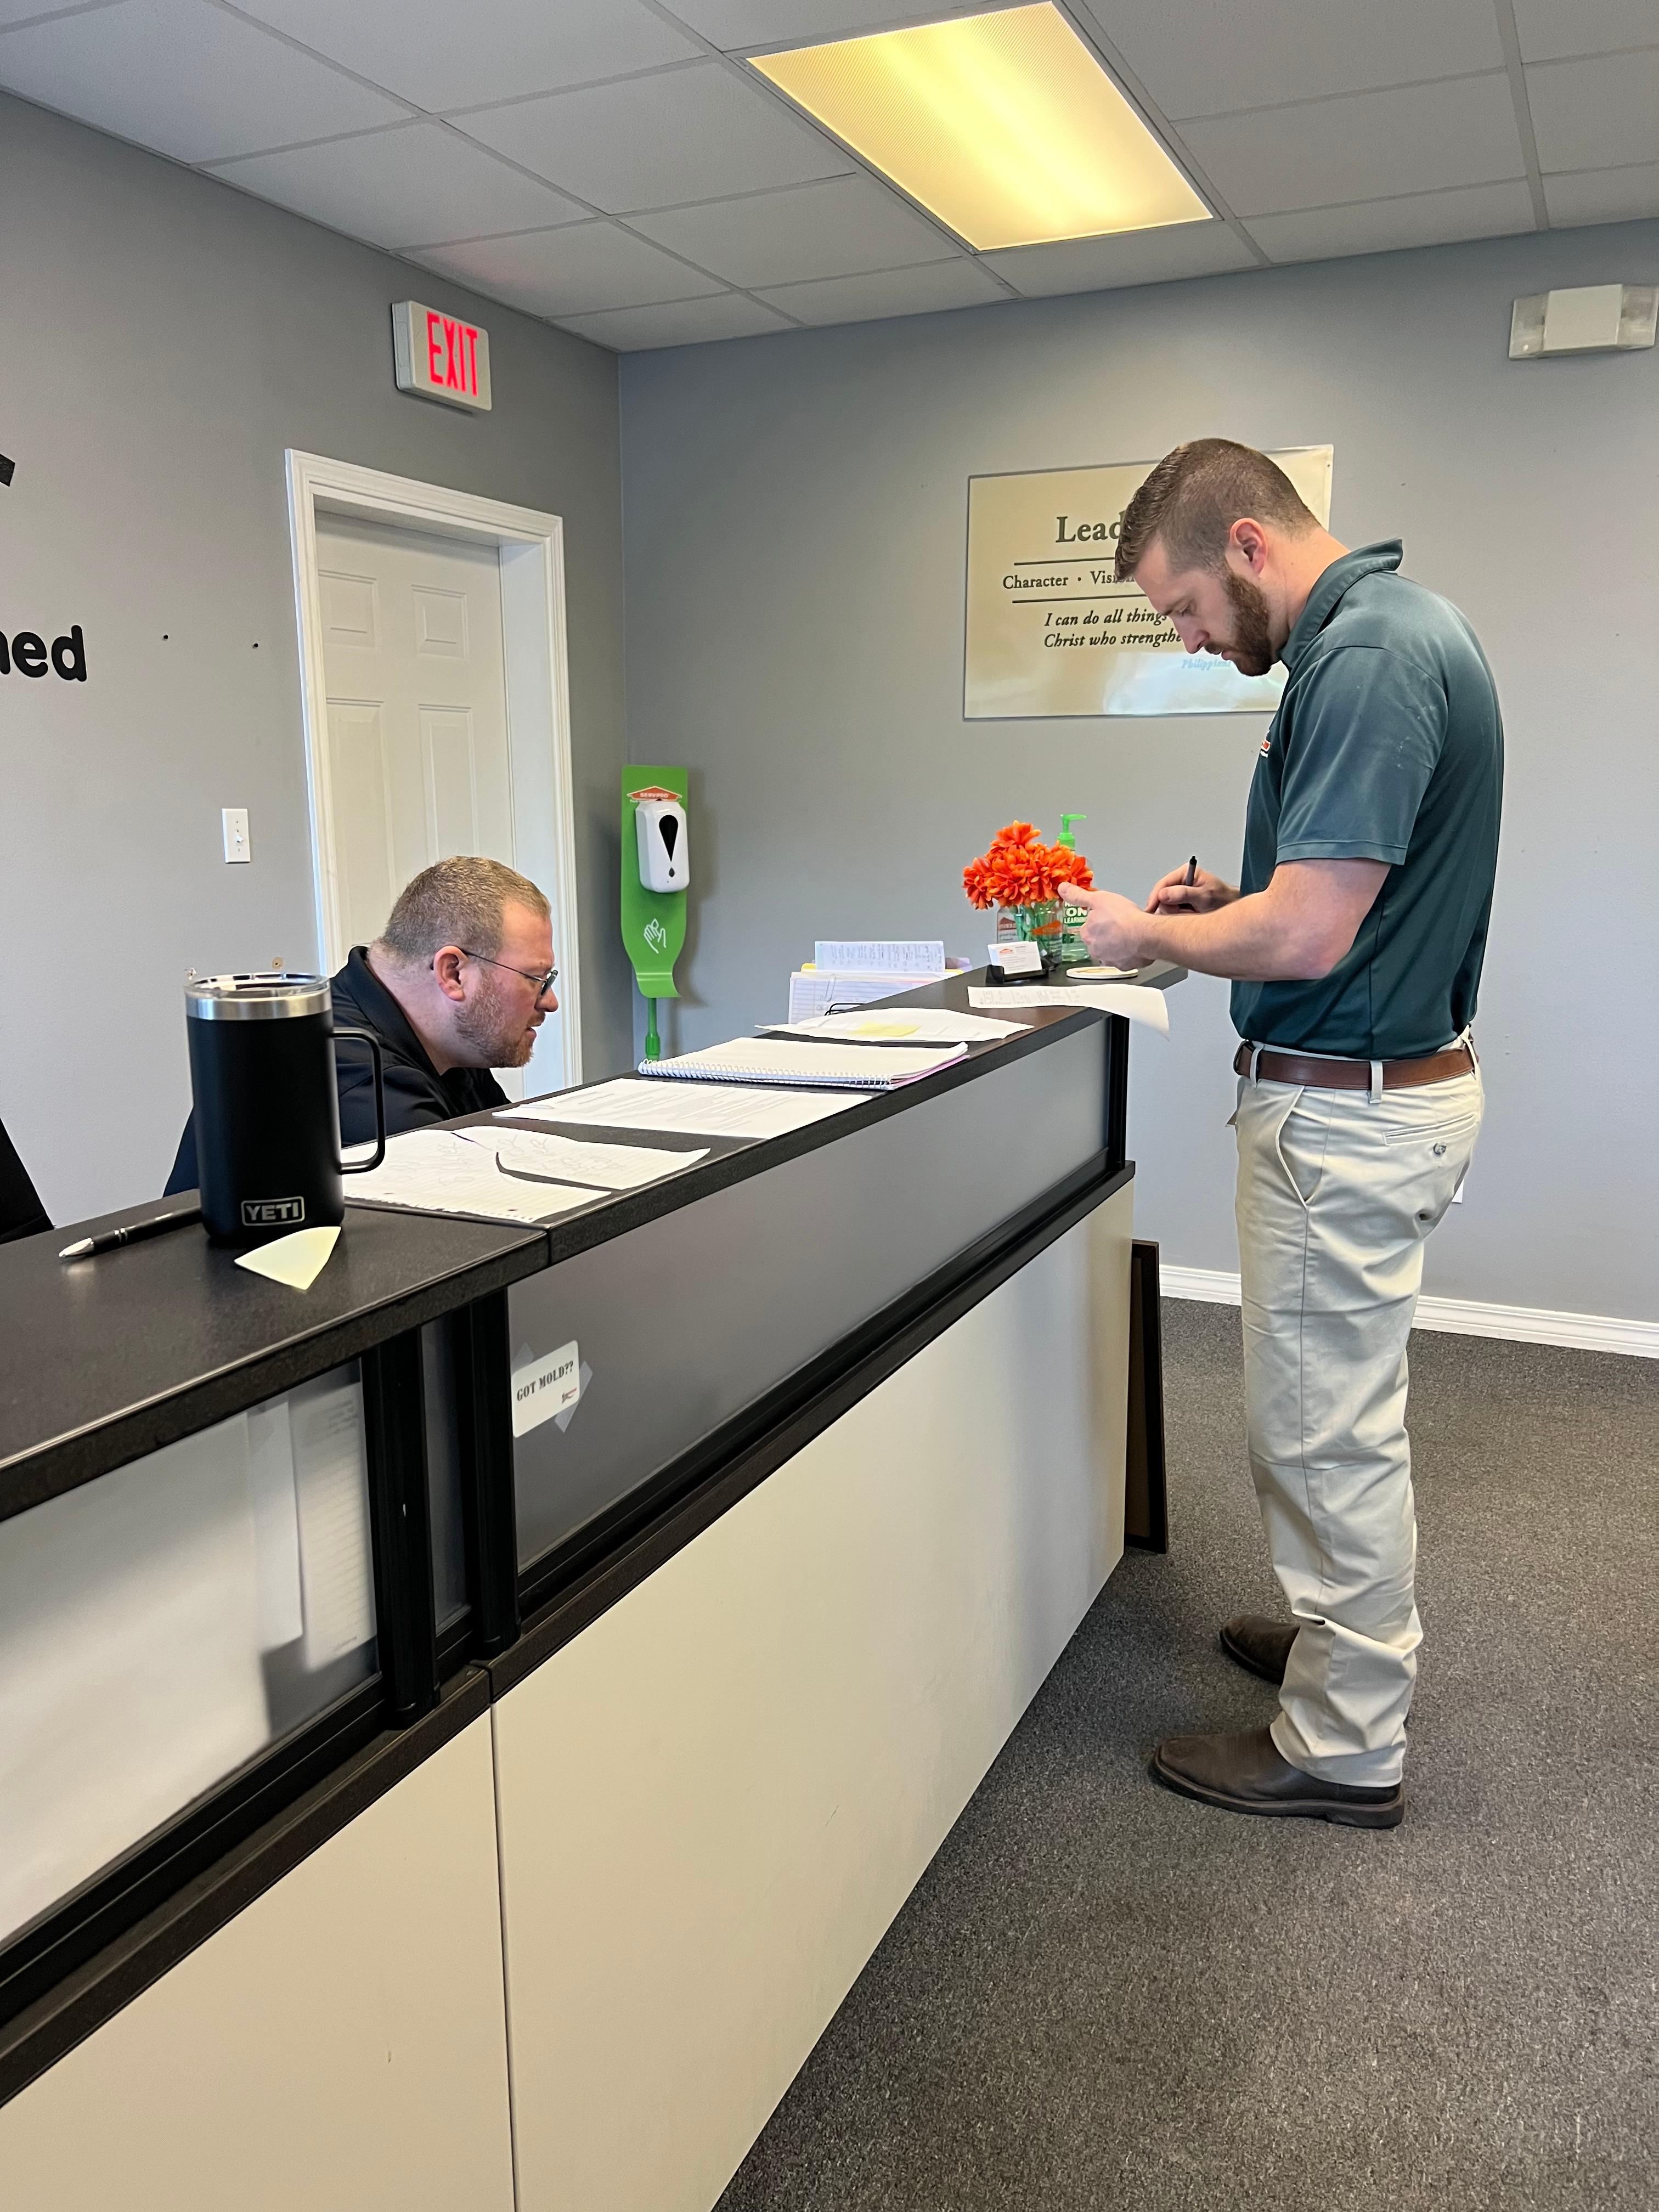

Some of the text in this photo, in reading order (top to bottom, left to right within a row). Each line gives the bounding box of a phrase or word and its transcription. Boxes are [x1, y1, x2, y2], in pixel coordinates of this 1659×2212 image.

[426, 311, 478, 397] EXIT
[1003, 574, 1069, 589] Character
[1045, 608, 1167, 626] I can do all things
[1044, 628, 1181, 647] Christ who strengthe
[1066, 907, 1087, 916] ON
[246, 1202, 298, 1221] YETI
[517, 1361, 573, 1401] GOT MOLD??
